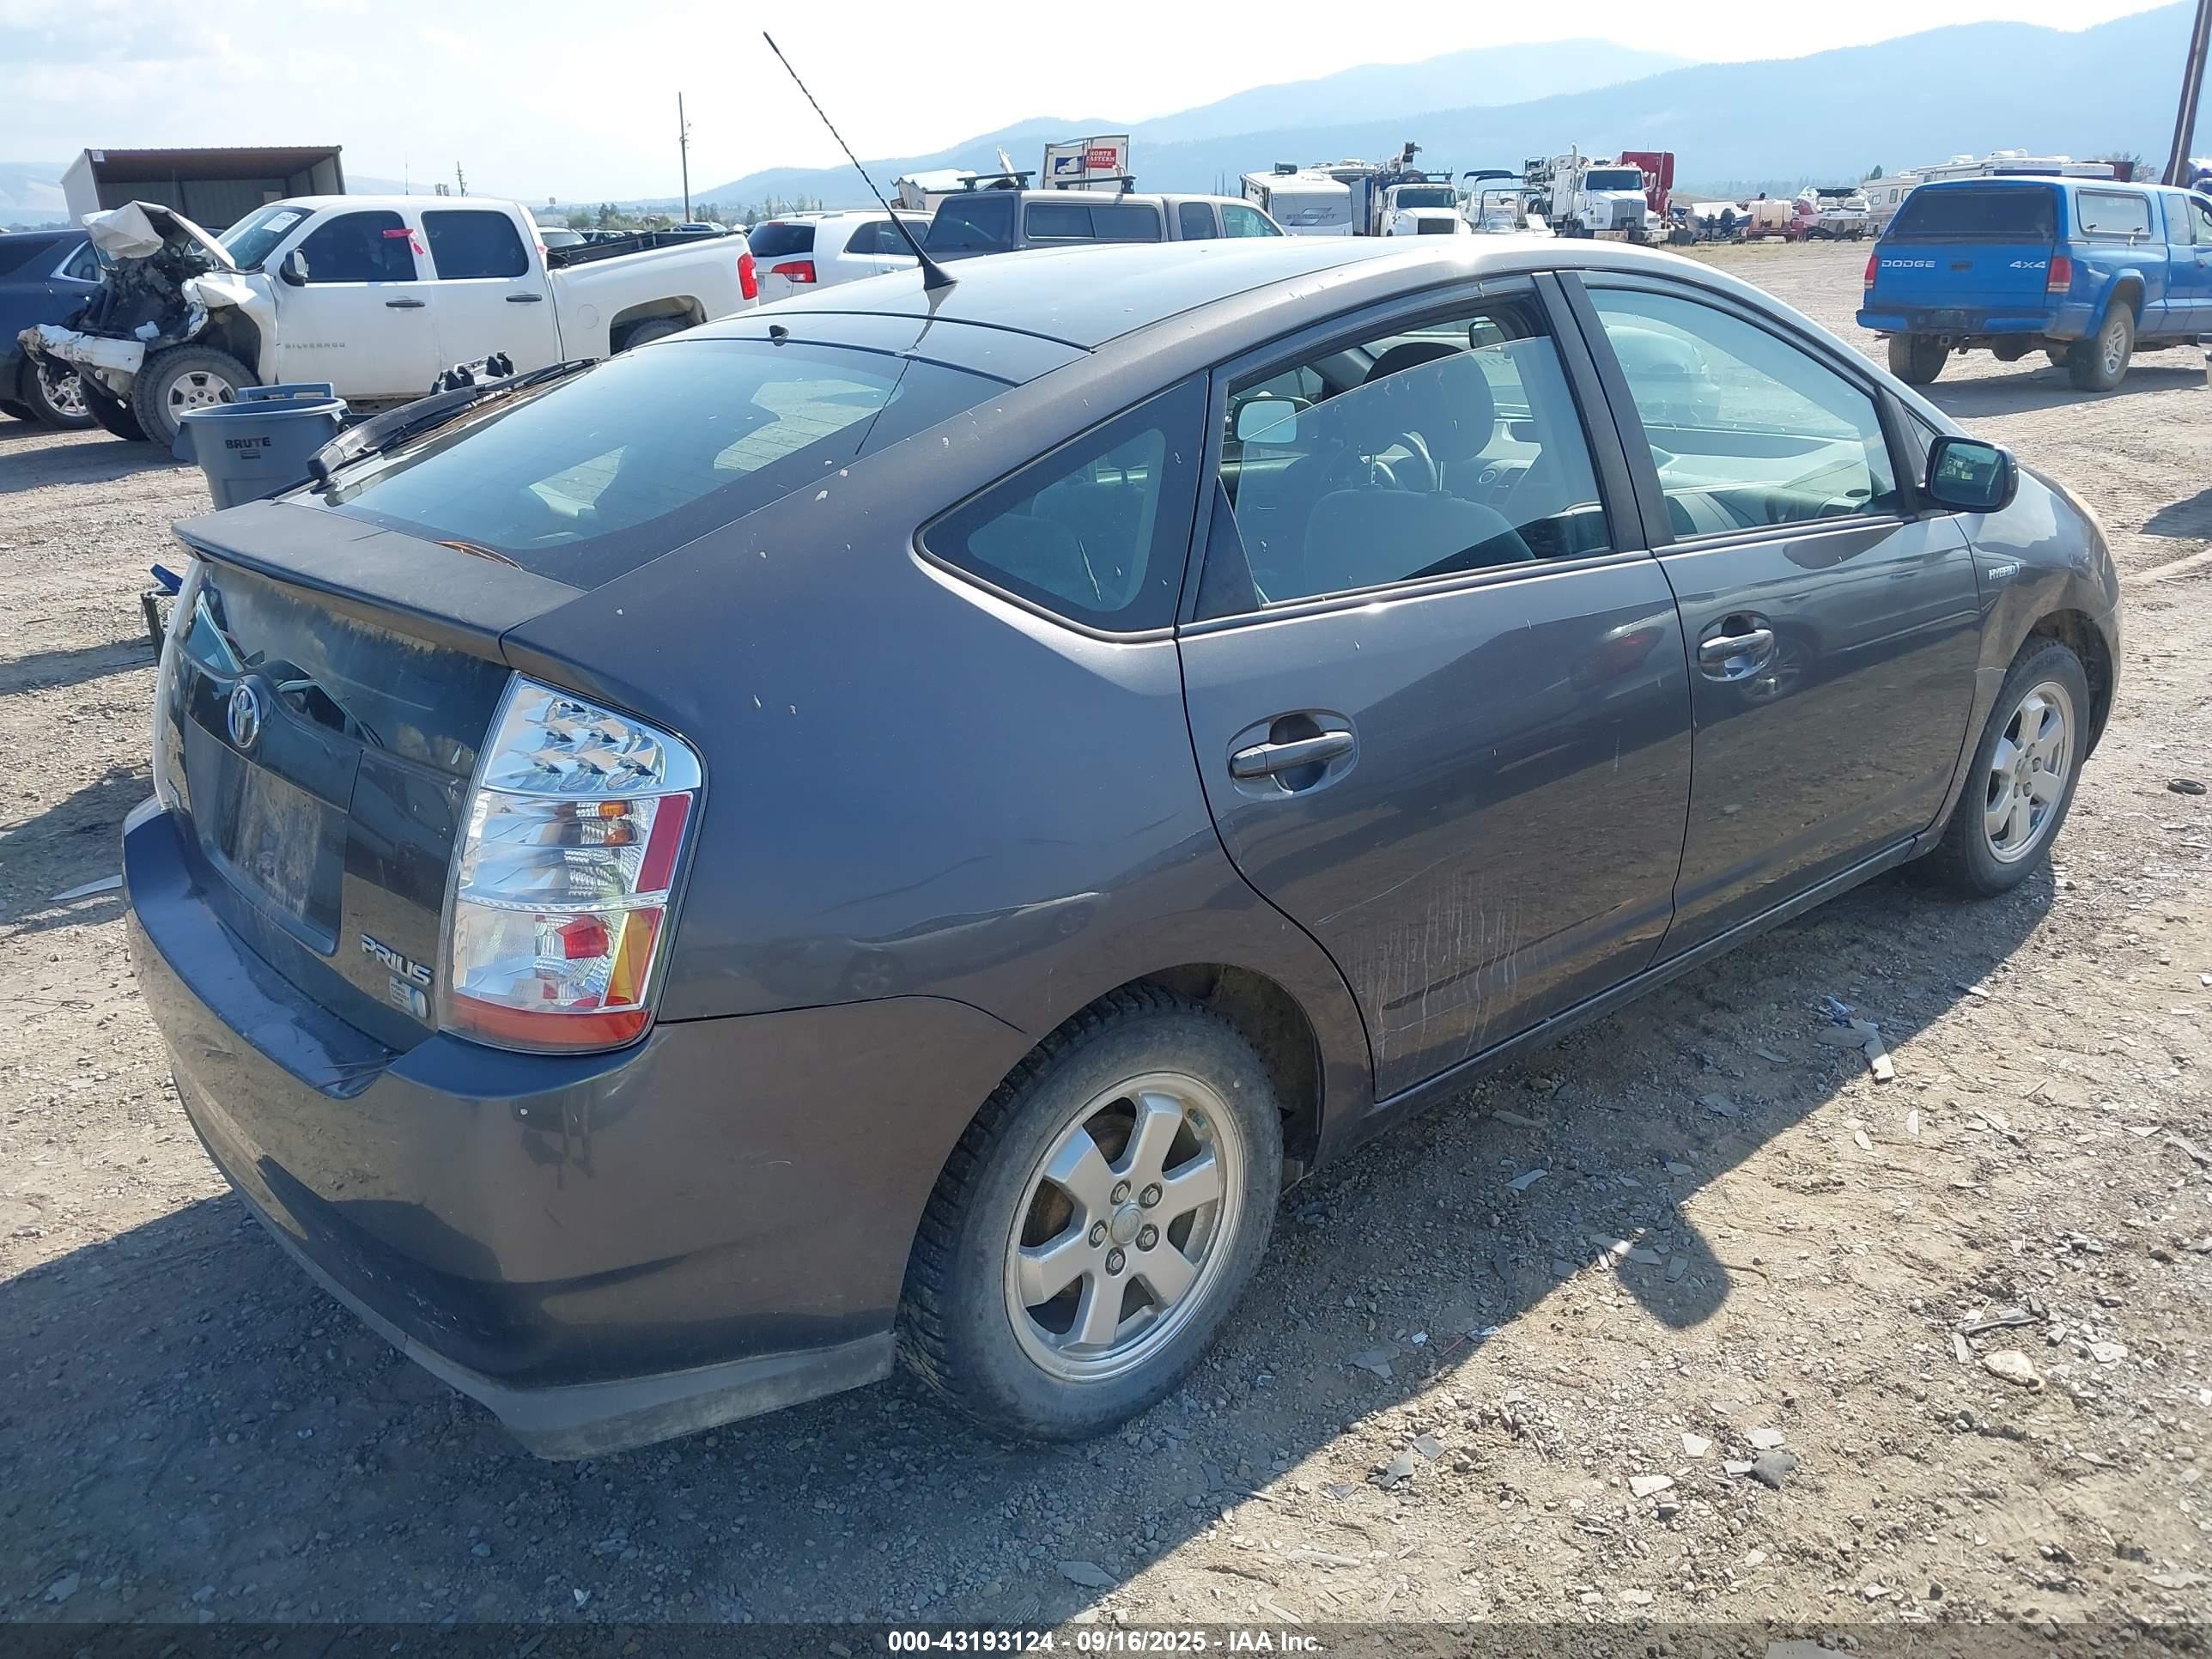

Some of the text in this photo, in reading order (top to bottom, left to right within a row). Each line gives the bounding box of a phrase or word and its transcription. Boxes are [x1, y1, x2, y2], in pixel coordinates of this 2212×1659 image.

[1881, 259, 1936, 269] DODGE
[225, 437, 272, 449] BRUTE
[1988, 565, 2015, 580] HYBRID
[361, 933, 433, 987] PRIUS
